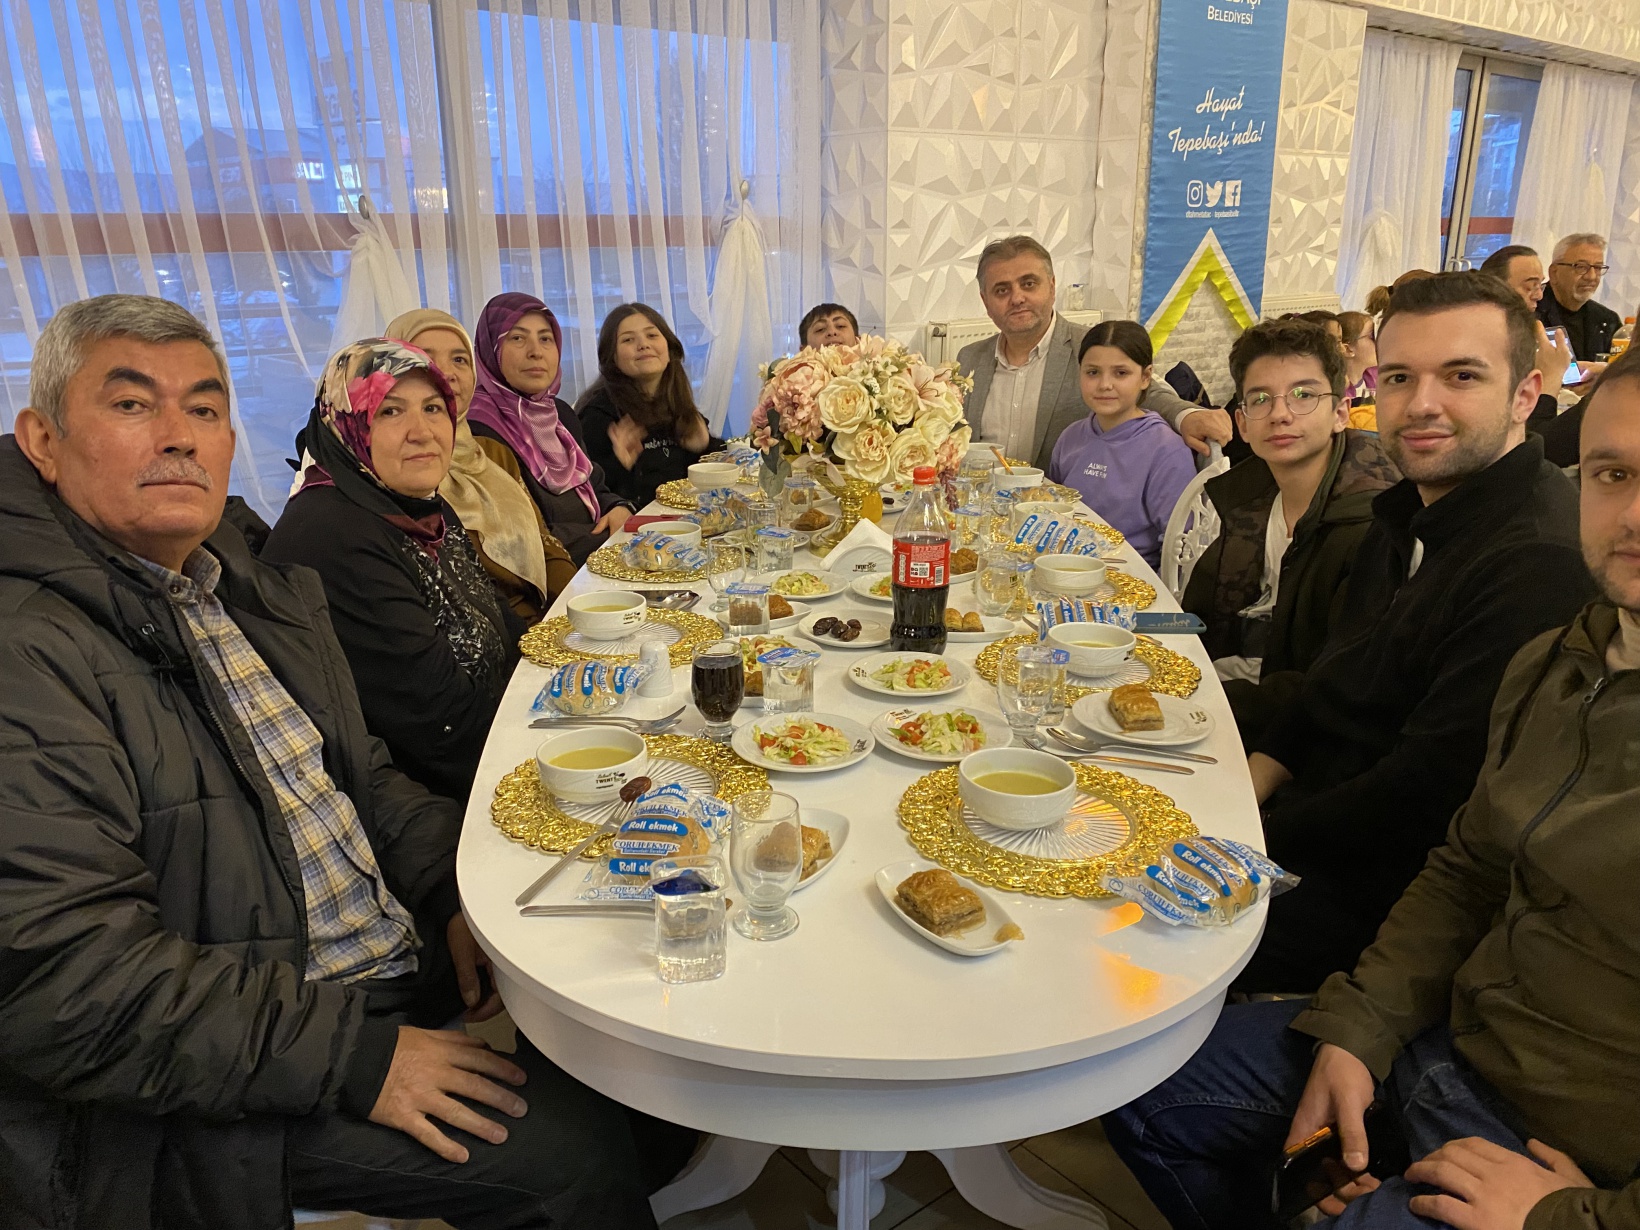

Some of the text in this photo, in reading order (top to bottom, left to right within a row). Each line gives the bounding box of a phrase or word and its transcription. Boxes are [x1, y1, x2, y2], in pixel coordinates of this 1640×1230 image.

[1207, 5, 1253, 25] BELEDİYESİ
[1195, 85, 1245, 121] Hayat
[1168, 119, 1266, 161] Tepebaşı'nda!
[628, 820, 679, 832] Roll ekmek
[1181, 849, 1202, 864] Roll
[619, 861, 637, 872] Roll
